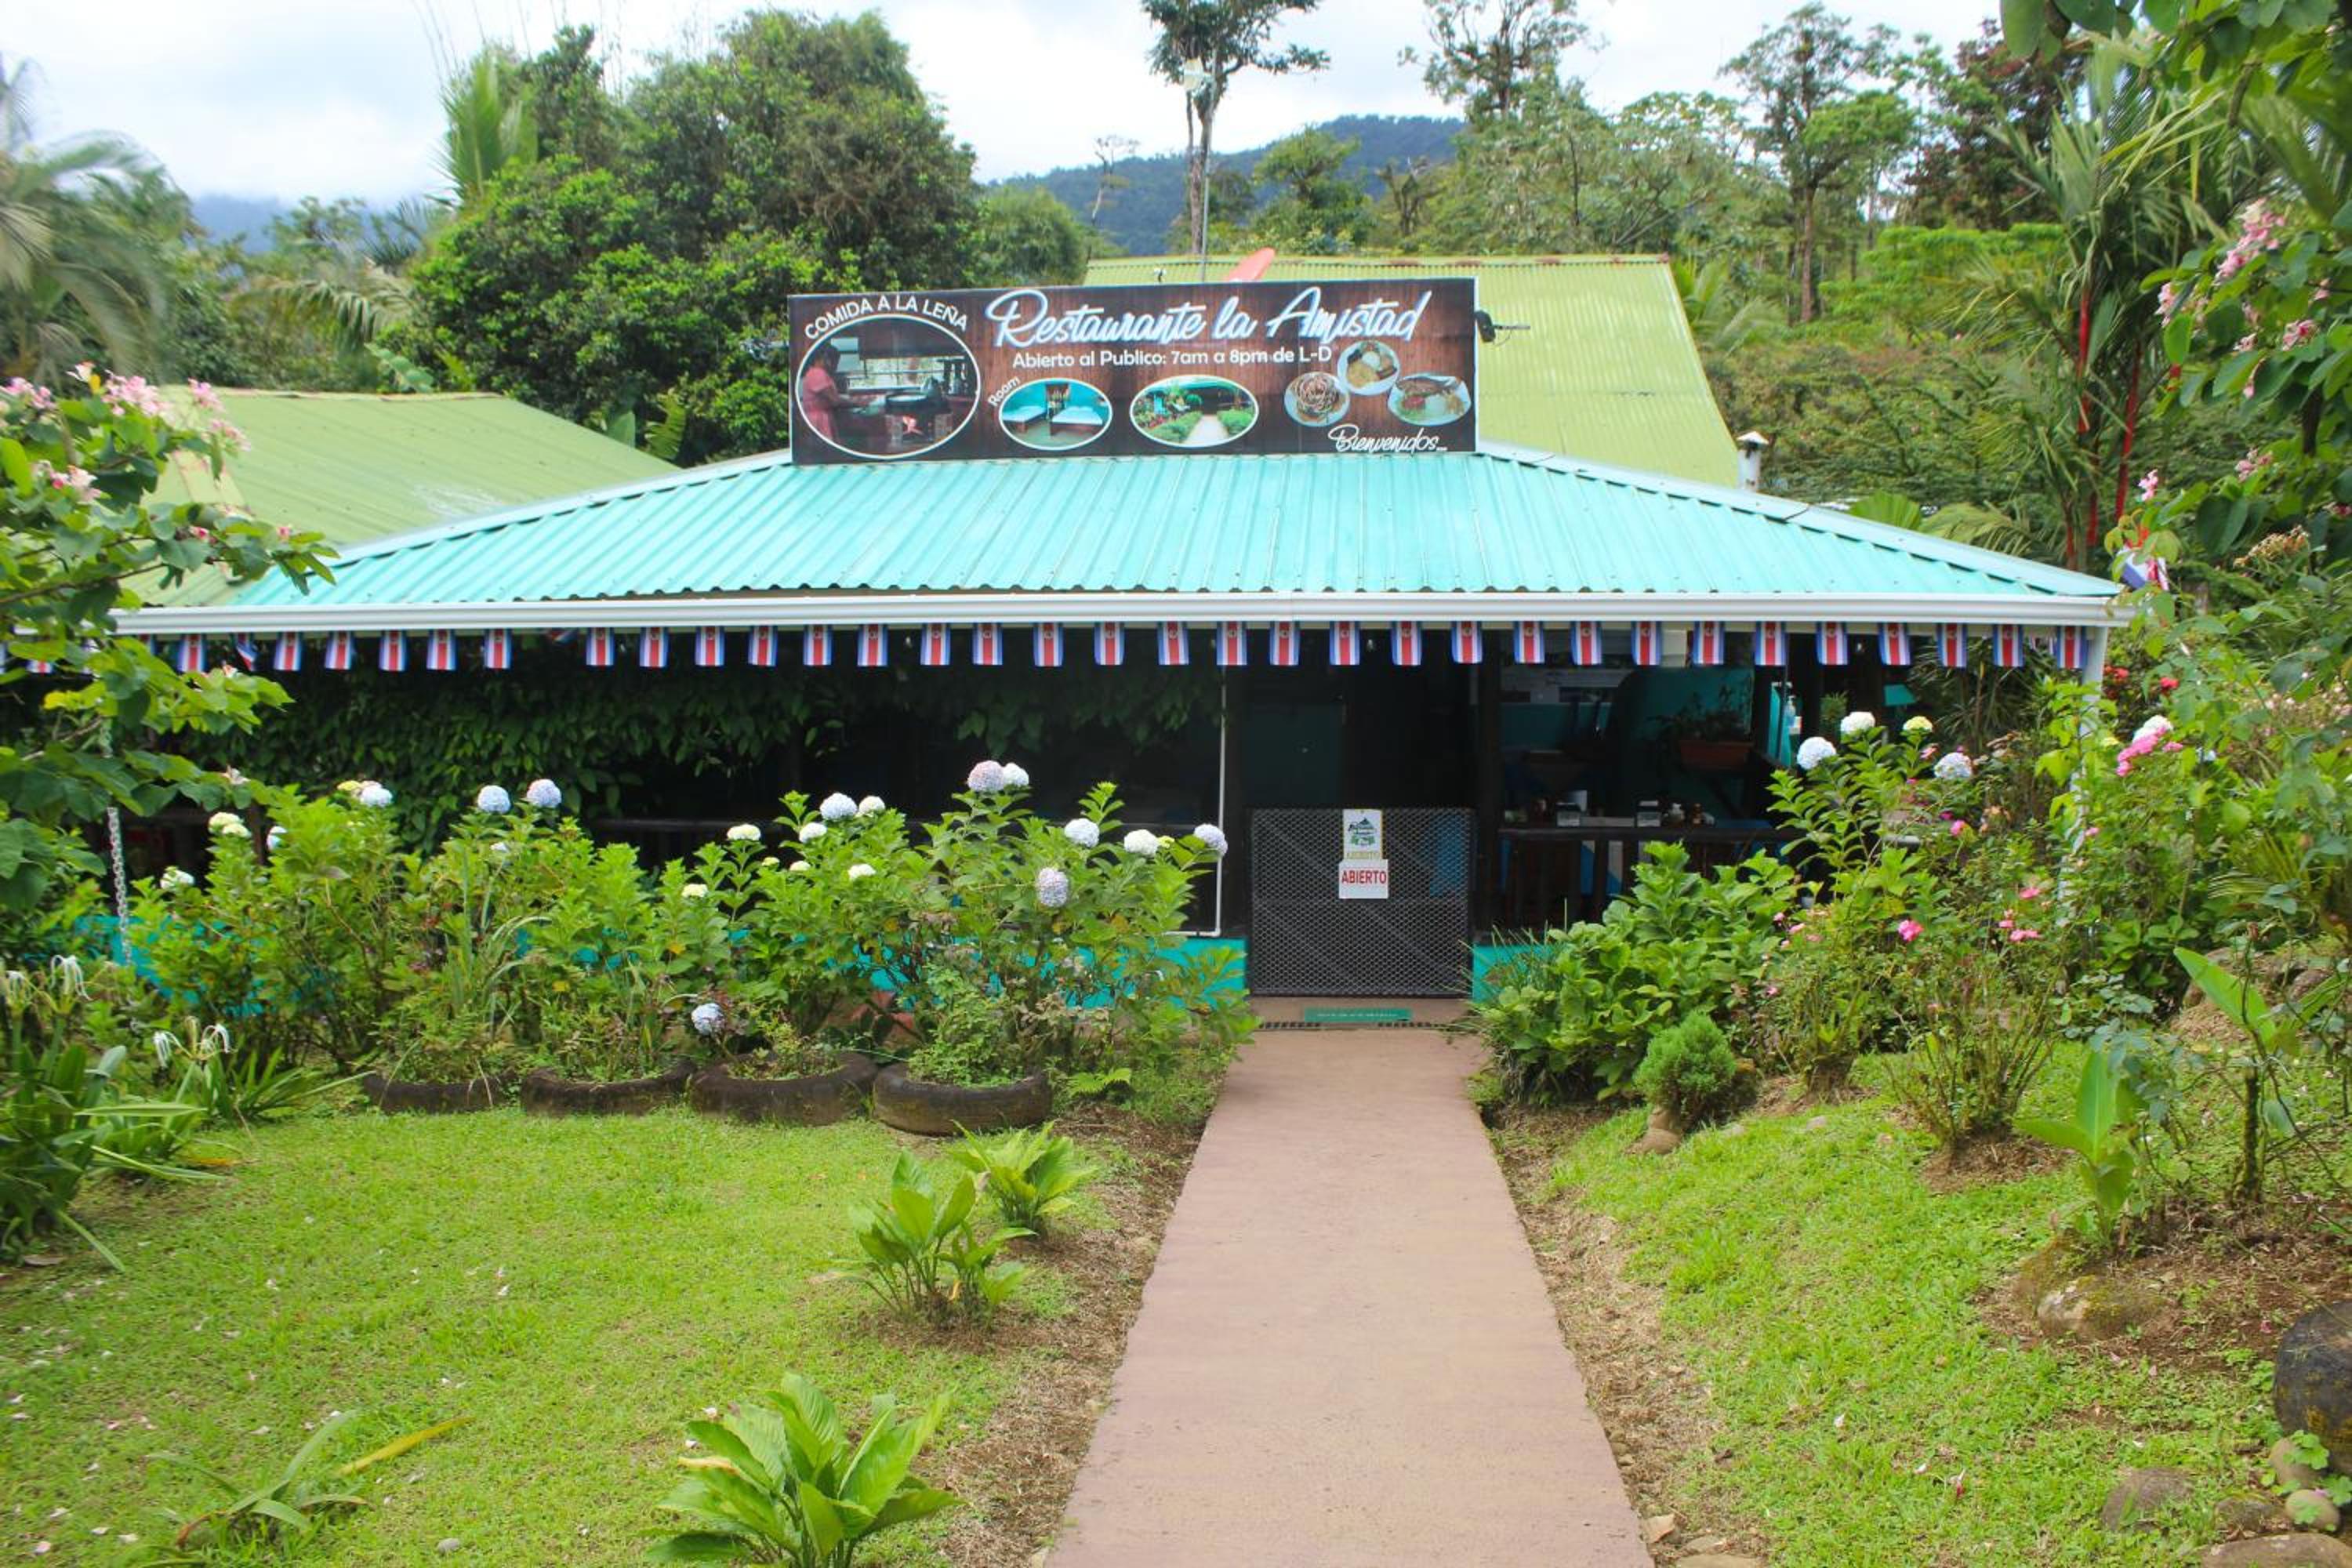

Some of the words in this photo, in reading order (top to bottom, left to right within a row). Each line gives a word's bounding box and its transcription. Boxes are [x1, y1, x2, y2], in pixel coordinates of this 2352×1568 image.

[805, 298, 873, 340] COMIDA
[877, 296, 891, 312] A
[895, 295, 919, 313] LA
[923, 299, 968, 332] LEÑA
[985, 289, 1207, 347] Restaurante
[1214, 296, 1258, 340] la
[1265, 287, 1432, 342] Amistad
[1013, 351, 1075, 368] Abierto
[1079, 350, 1095, 367] al
[1100, 350, 1167, 368] Publico:
[1171, 350, 1208, 365] 7am
[1214, 352, 1225, 365] a
[1229, 349, 1268, 365] 8pm
[1272, 347, 1294, 363] de
[1299, 347, 1331, 362] L-D
[988, 376, 1021, 407] Room
[1342, 869, 1387, 884] ABIERTO
